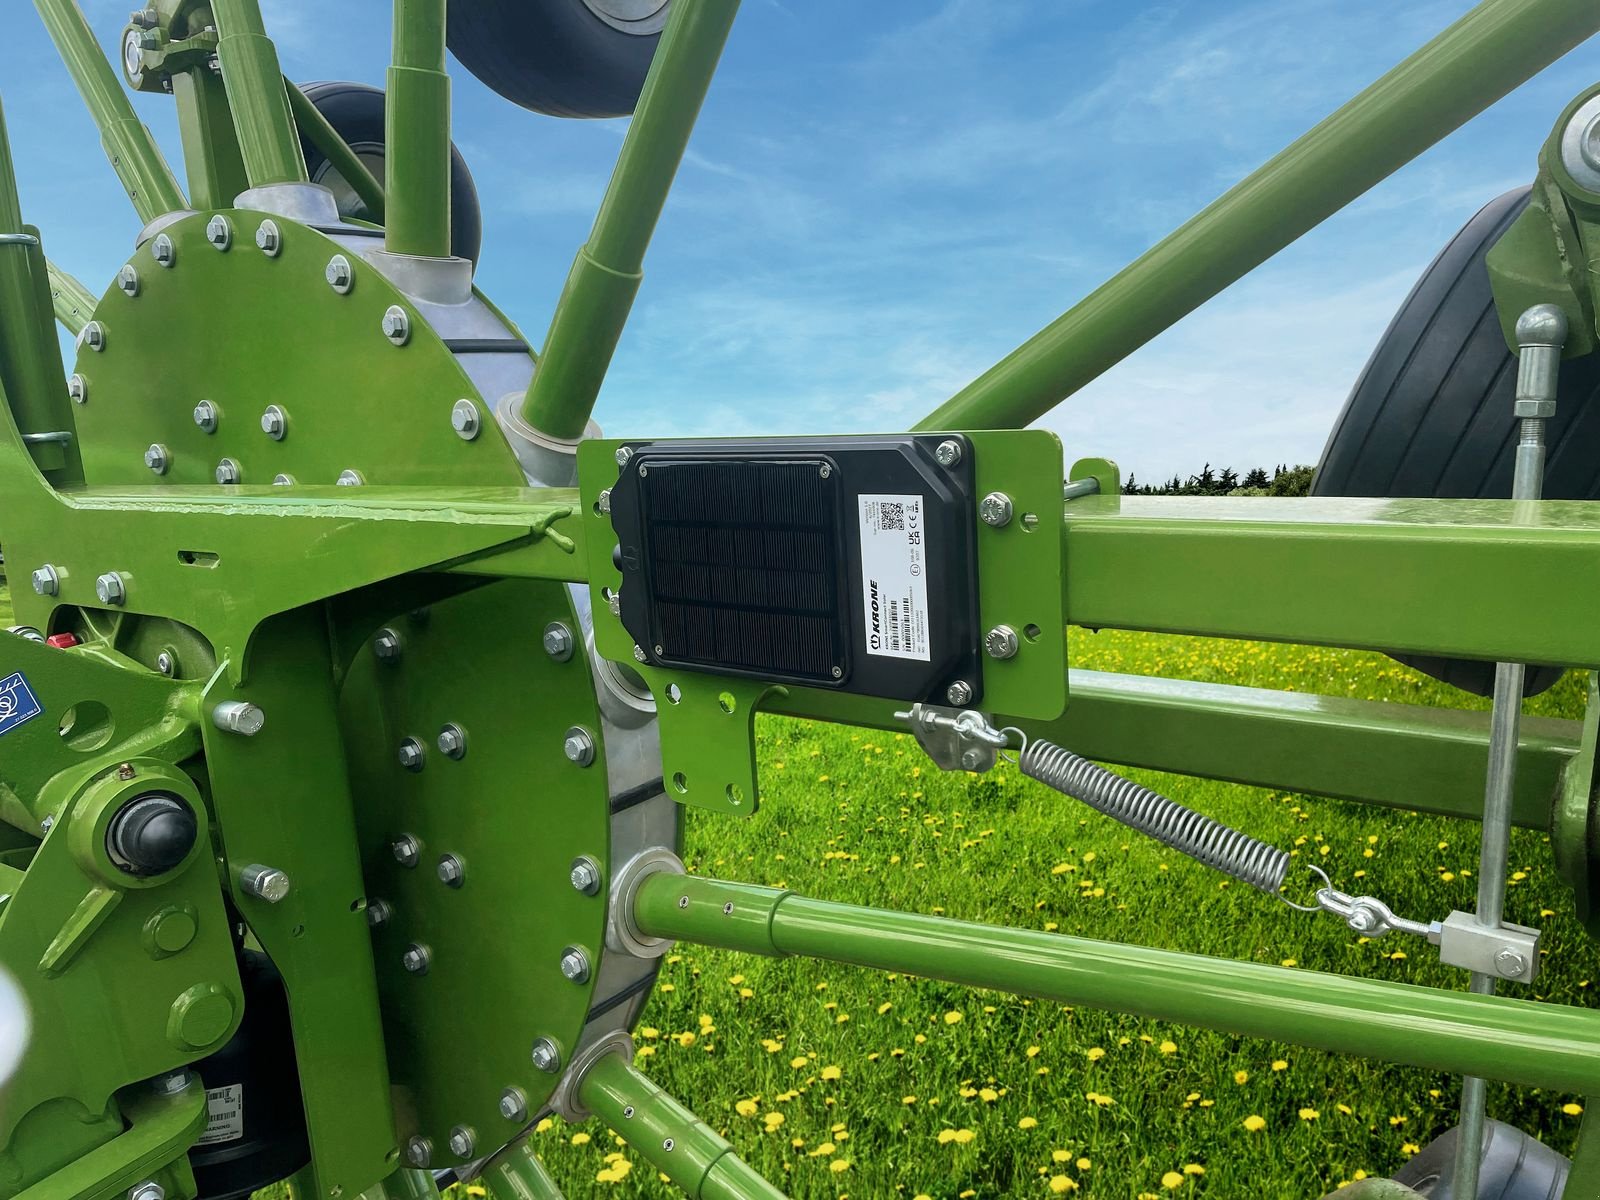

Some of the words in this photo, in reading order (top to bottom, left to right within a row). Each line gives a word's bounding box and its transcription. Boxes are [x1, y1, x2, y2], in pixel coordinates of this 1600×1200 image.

[909, 532, 914, 544] UK
[914, 531, 920, 544] CA
[870, 580, 880, 633] KRONE
